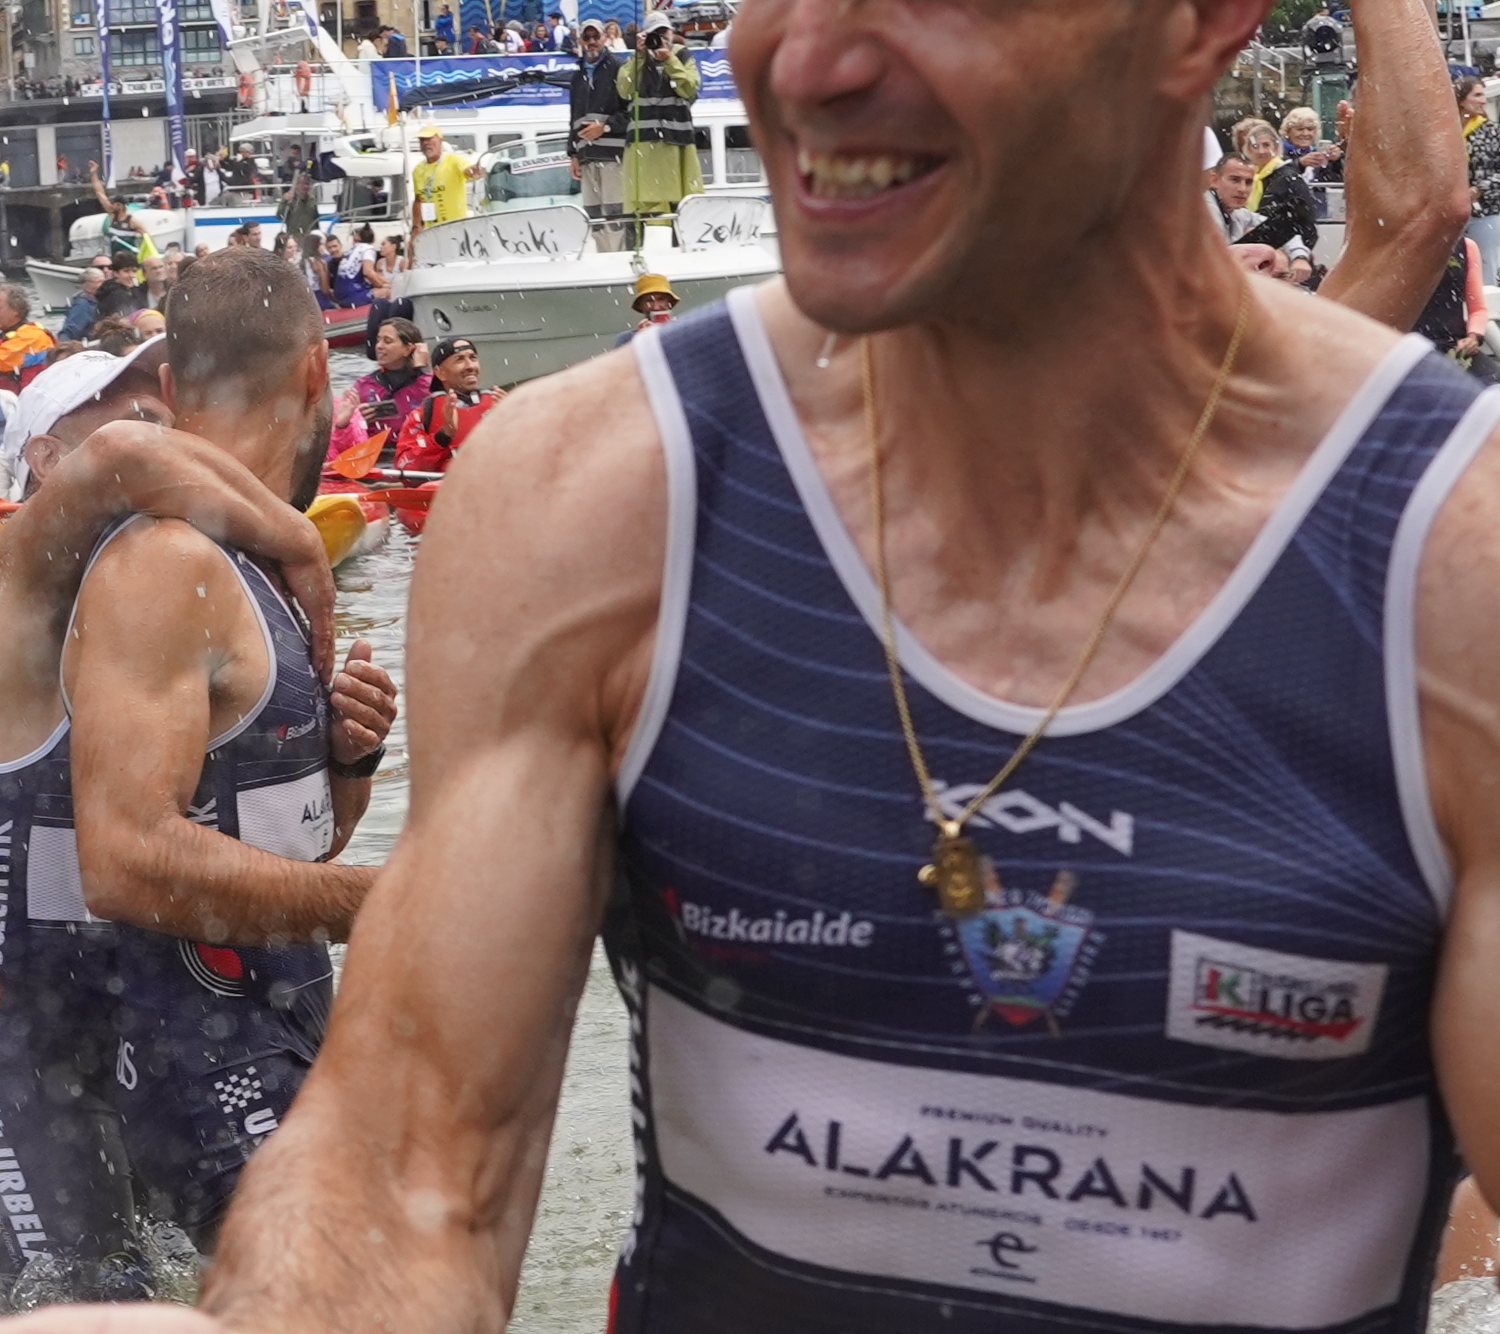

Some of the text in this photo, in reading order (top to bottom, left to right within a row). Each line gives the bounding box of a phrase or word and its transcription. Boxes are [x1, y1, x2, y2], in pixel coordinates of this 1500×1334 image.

[680, 901, 877, 949] Bizkaialde
[1258, 987, 1356, 1024] LIGA
[918, 1104, 1110, 1139] PREMIUM QUALITY
[764, 1111, 1259, 1223] ALAKRANA
